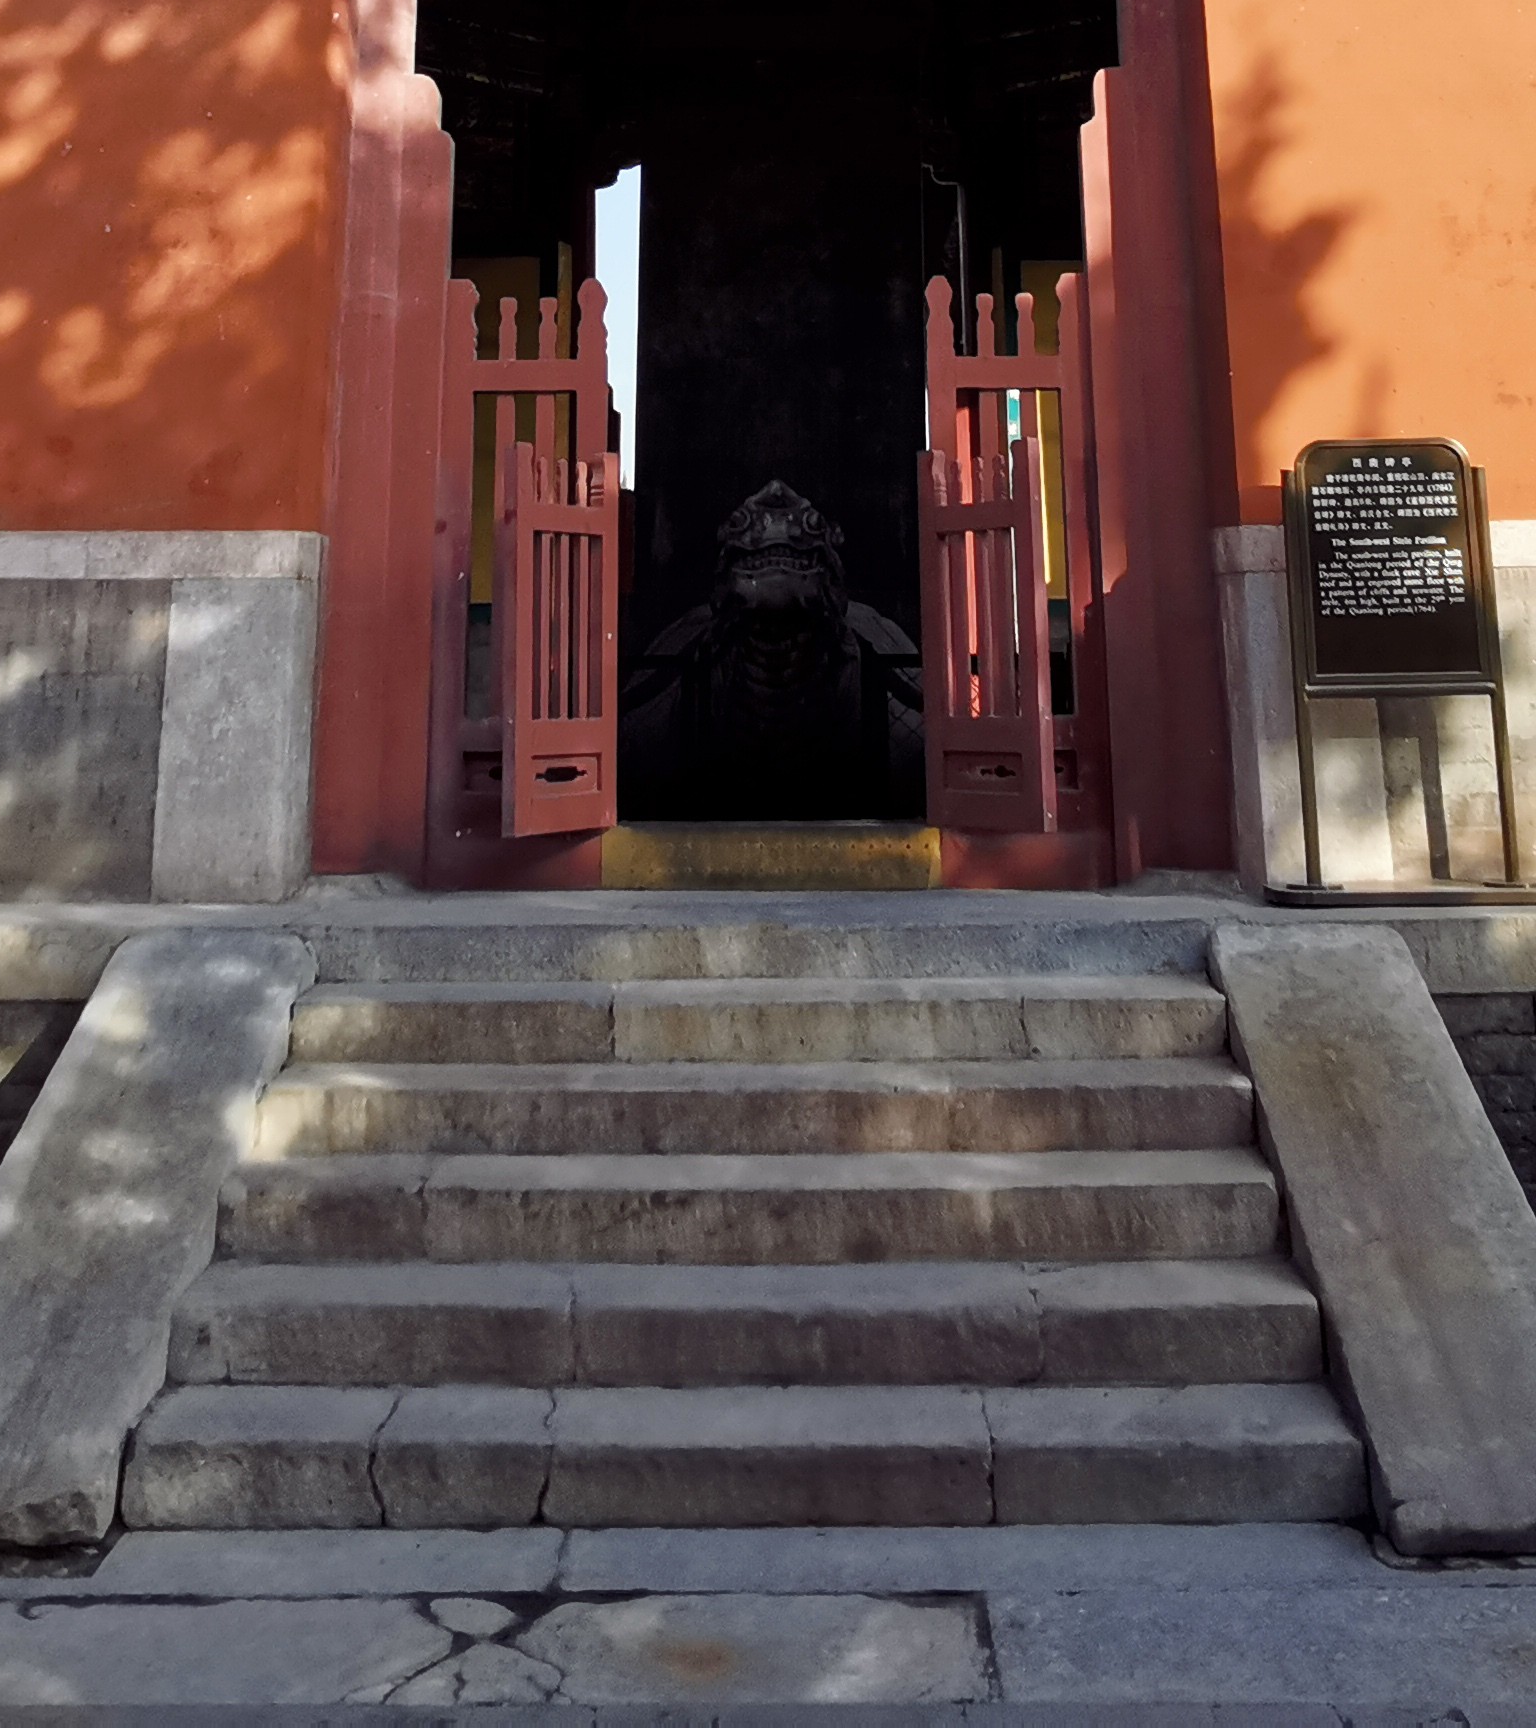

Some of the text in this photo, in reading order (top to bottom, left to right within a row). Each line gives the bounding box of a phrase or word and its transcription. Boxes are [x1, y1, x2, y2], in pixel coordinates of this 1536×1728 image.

[1330, 538, 1346, 546] The
[1335, 552, 1348, 560] The
[1330, 561, 1343, 569] the
[1386, 559, 1411, 569] period
[1414, 558, 1424, 568] of
[1426, 558, 1439, 567] the
[1393, 586, 1408, 595] and
[1449, 585, 1465, 594] The
[1334, 607, 1346, 615] the
